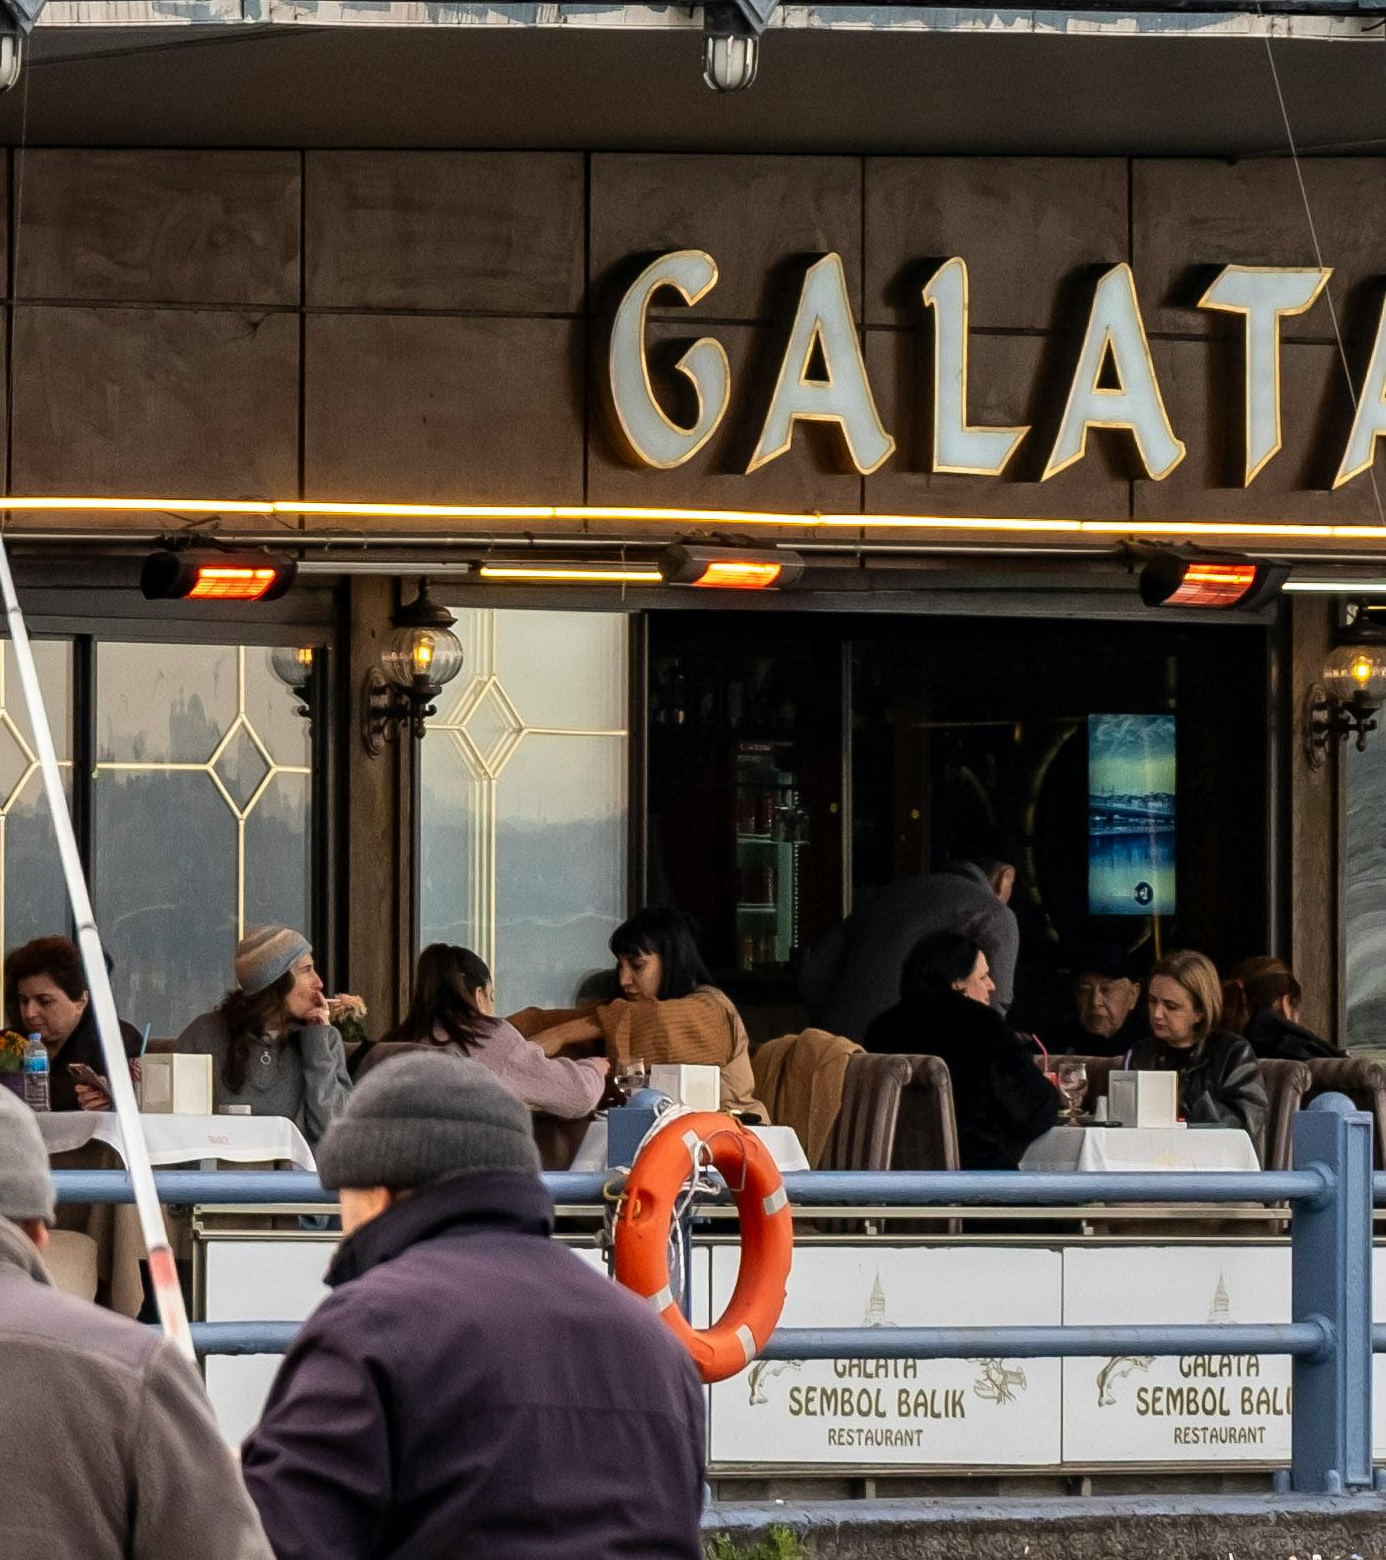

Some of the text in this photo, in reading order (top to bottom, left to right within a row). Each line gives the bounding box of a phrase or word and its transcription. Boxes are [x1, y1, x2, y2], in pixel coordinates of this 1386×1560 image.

[1179, 1355, 1260, 1378] GALATA
[789, 1386, 966, 1419] SEMBOL BALIK
[1136, 1386, 1292, 1416] SEMBOL BALI
[828, 1428, 924, 1447] RESTAURANT
[1174, 1426, 1266, 1444] RESTAURANT
